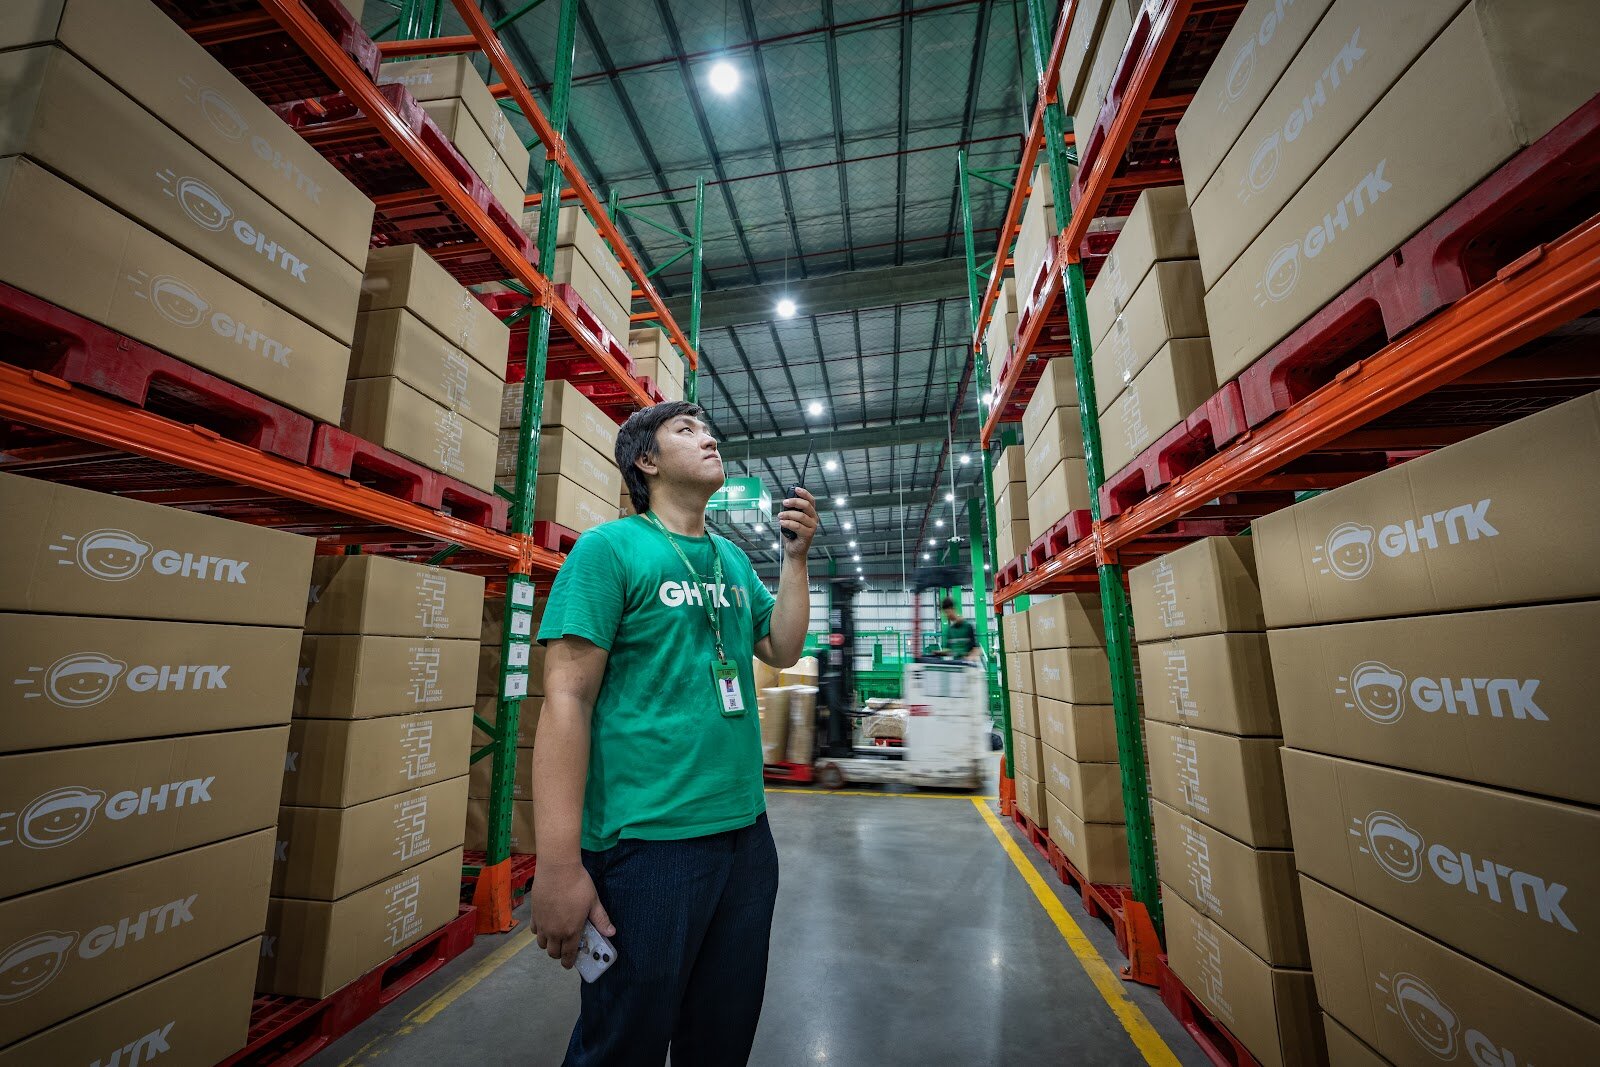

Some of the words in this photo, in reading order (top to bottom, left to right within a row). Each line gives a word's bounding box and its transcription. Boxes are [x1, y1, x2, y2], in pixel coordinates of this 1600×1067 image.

[1283, 26, 1367, 143] GHTK
[252, 135, 323, 205] GHTK
[1304, 158, 1392, 258] GHTK
[233, 220, 310, 284] GHTK
[210, 313, 294, 369] GHTK
[1379, 499, 1500, 558] GHTK
[152, 549, 250, 585] GHTK
[126, 665, 231, 692] GHTK
[1410, 677, 1550, 721] GHTK
[105, 776, 216, 820] GHTK
[1427, 844, 1579, 933] GHTK
[78, 893, 198, 960] GHTK
